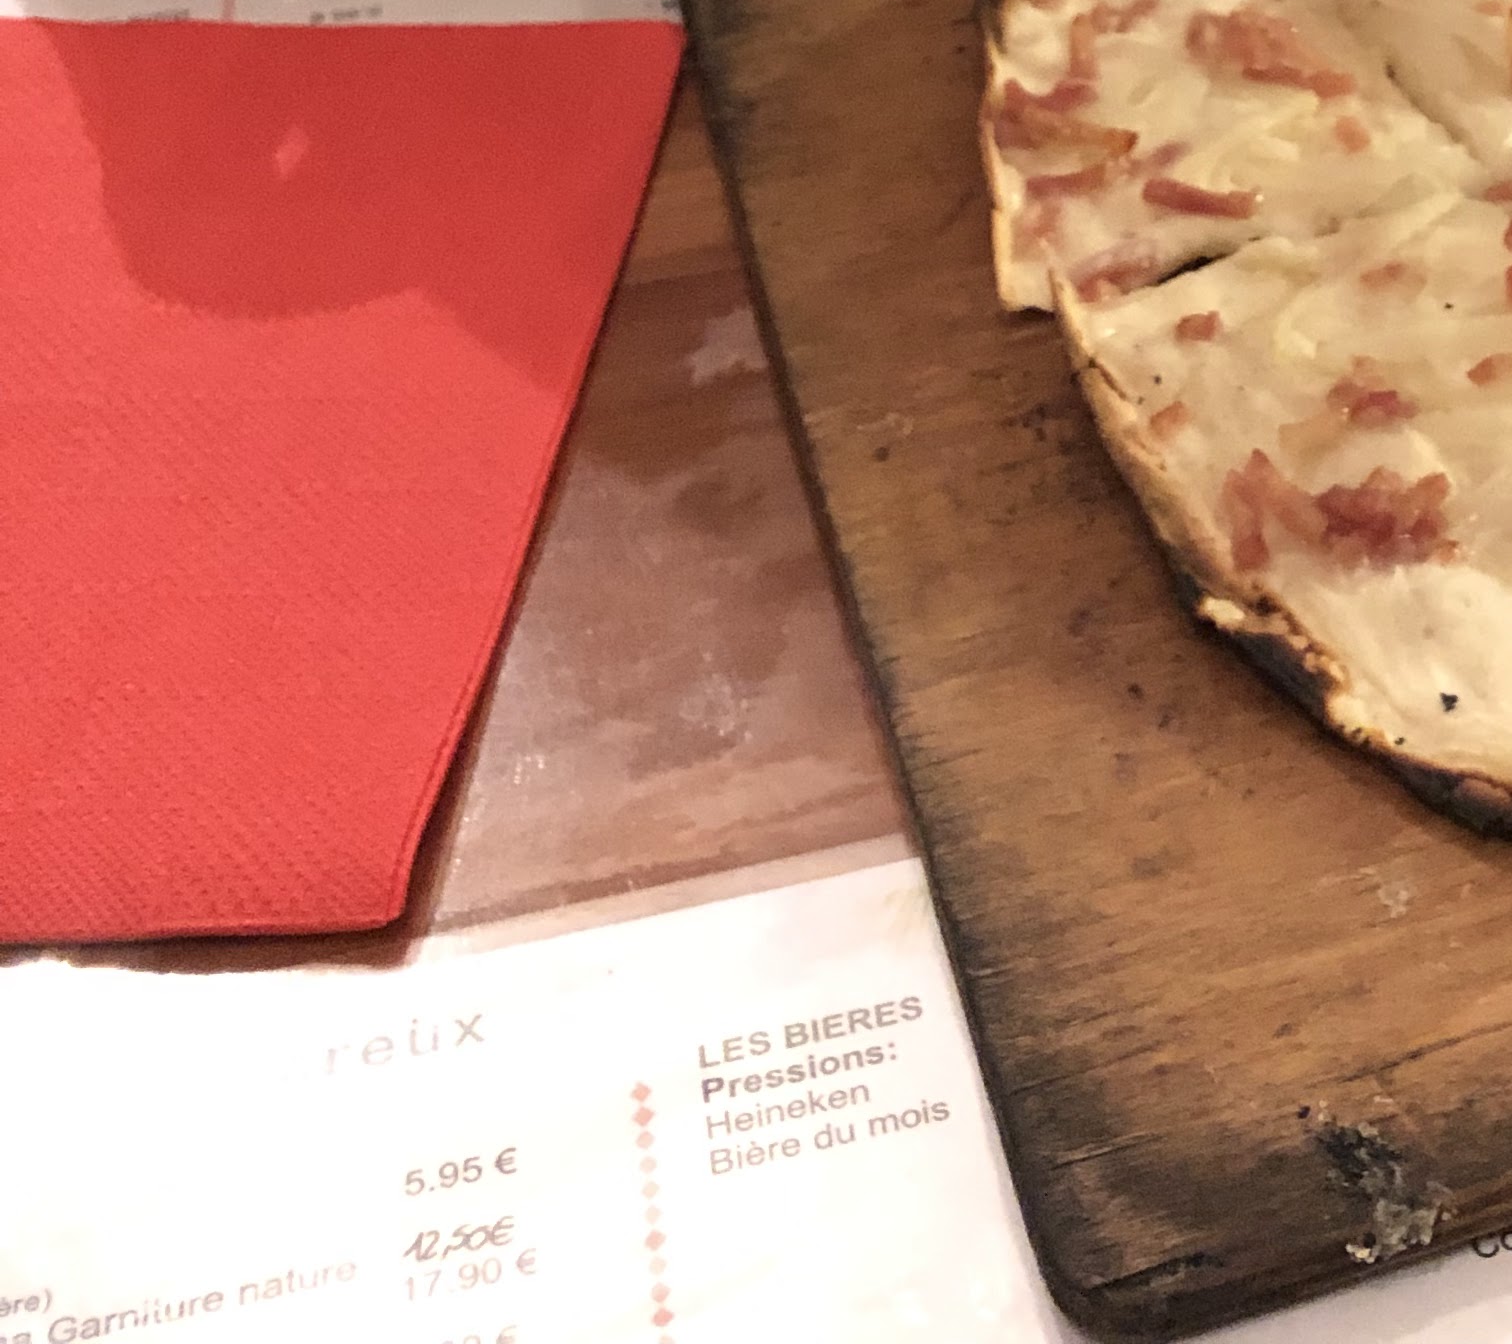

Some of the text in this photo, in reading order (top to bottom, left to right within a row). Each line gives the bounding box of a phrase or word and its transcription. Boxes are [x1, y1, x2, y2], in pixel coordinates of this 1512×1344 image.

[698, 996, 923, 1069] LES BIERES
[701, 1042, 897, 1103] Pressions:
[706, 1084, 871, 1139] Heineken
[710, 1100, 950, 1175] Bière du mois
[405, 1147, 518, 1196] 5.95 €
[48, 1260, 357, 1344] Garniture nature
